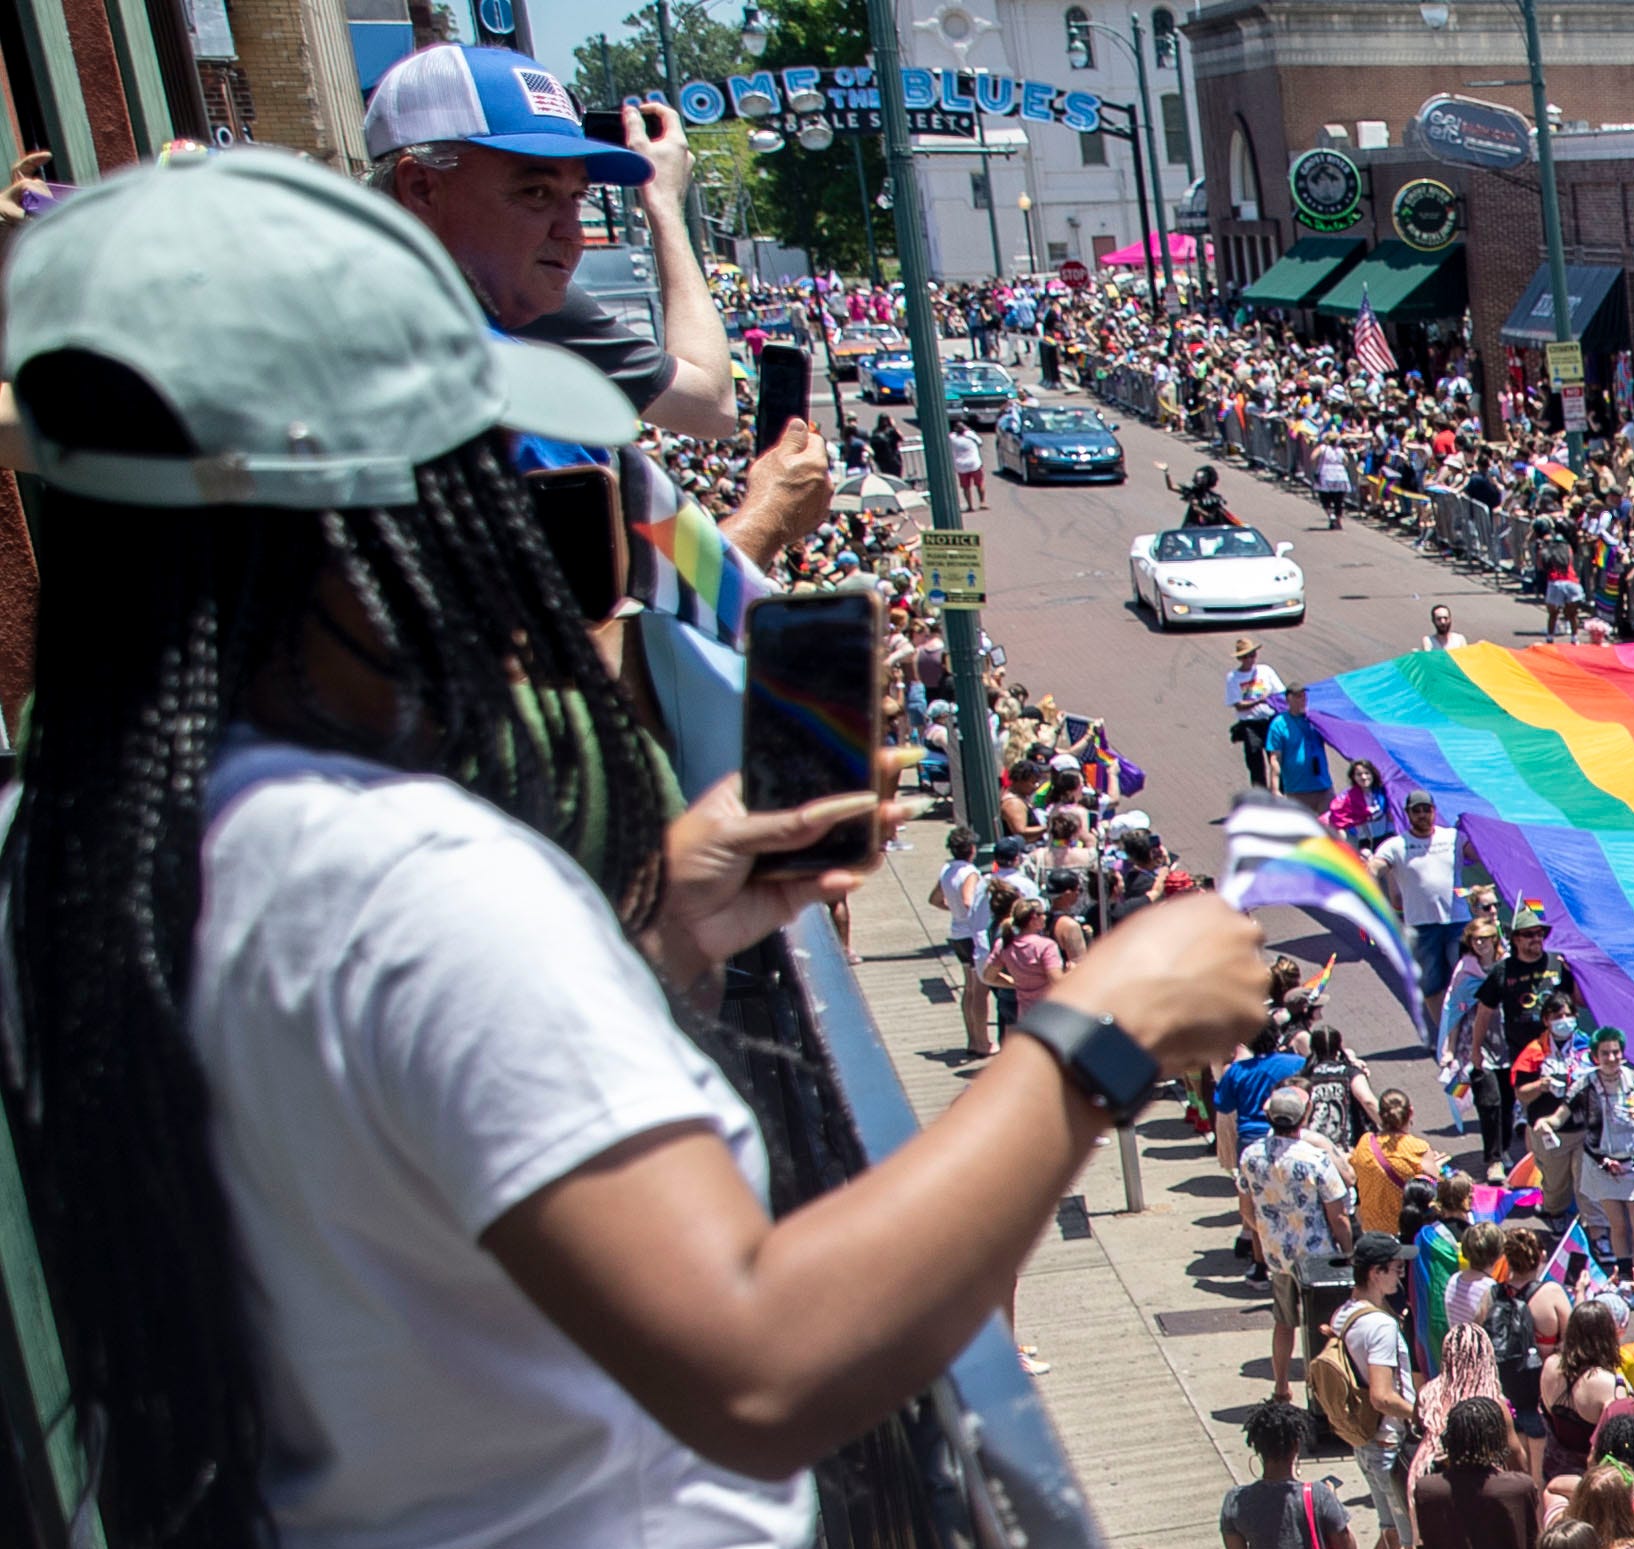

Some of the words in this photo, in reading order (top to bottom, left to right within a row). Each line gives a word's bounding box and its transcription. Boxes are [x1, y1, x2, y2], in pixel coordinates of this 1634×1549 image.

[624, 66, 832, 124] OME
[900, 67, 1101, 133] BLUES
[869, 111, 958, 130] SREET
[1061, 269, 1087, 282] STOP
[925, 536, 977, 545] NOTICE
